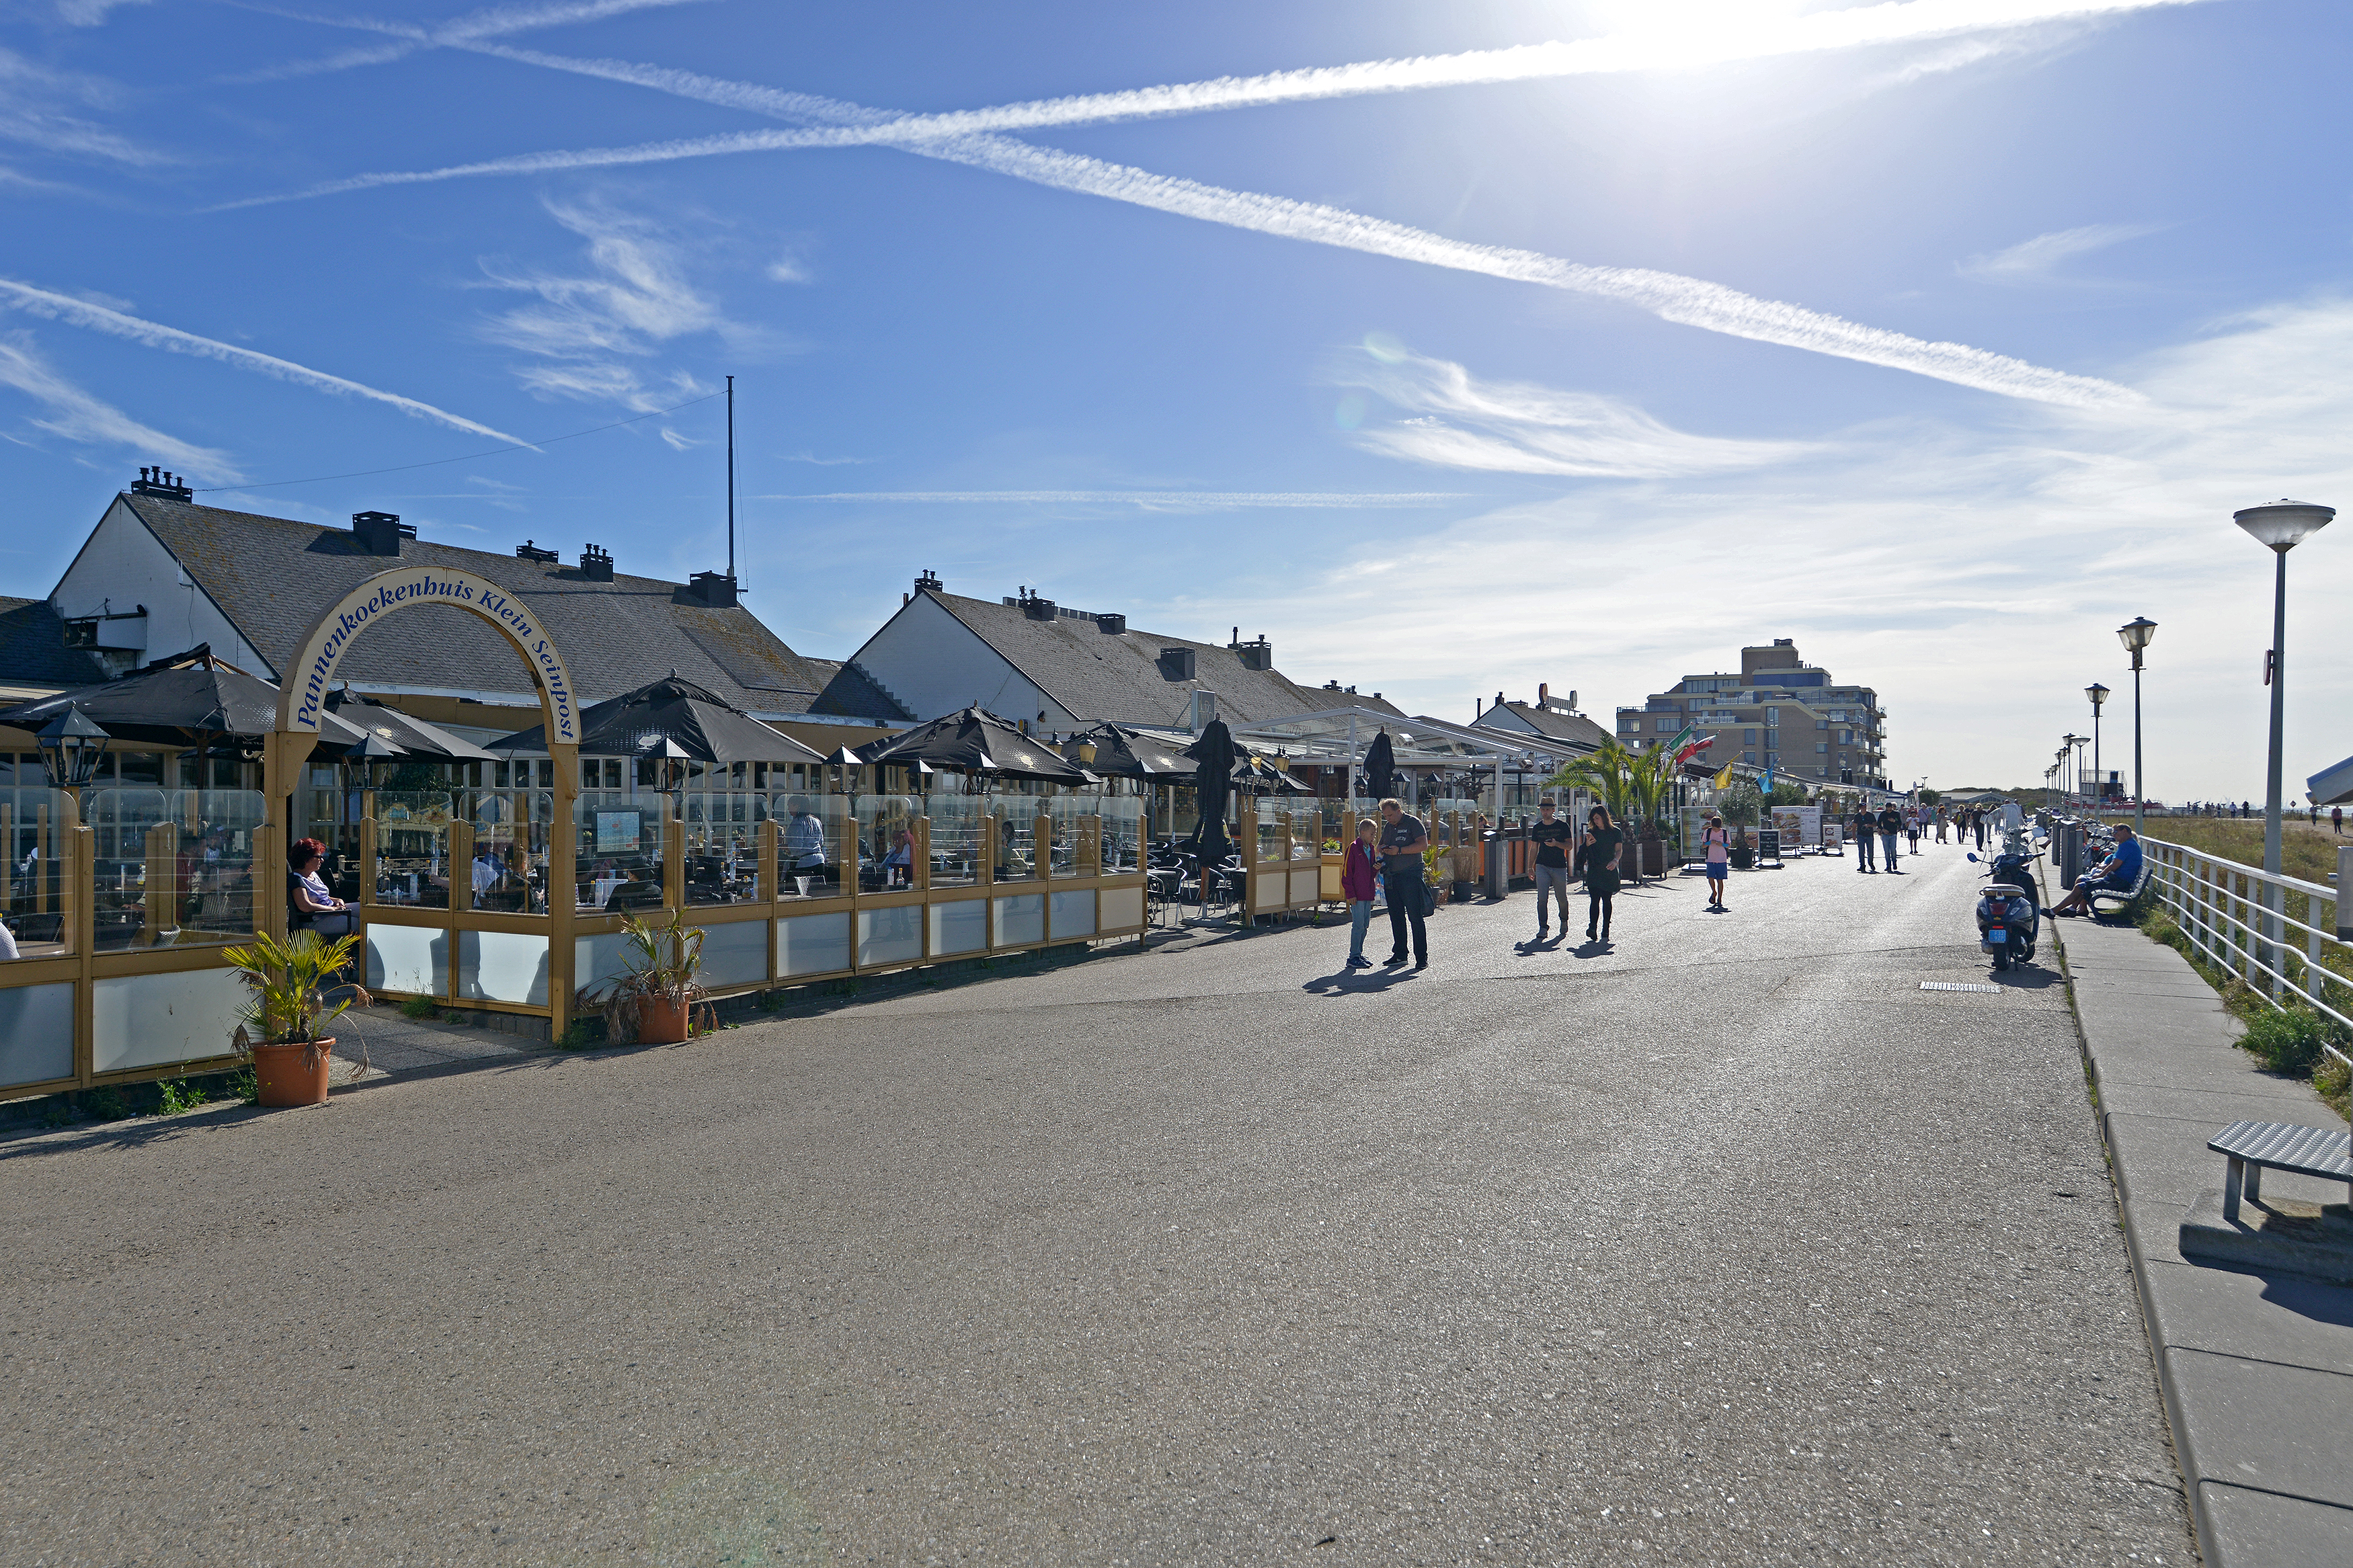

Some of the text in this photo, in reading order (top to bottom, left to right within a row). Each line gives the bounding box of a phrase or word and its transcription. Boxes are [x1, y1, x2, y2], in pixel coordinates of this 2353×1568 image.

[298, 575, 574, 739] Pannenkoekenhuis Klein Seinpost
[1285, 723, 1312, 735] PIZZERIA
